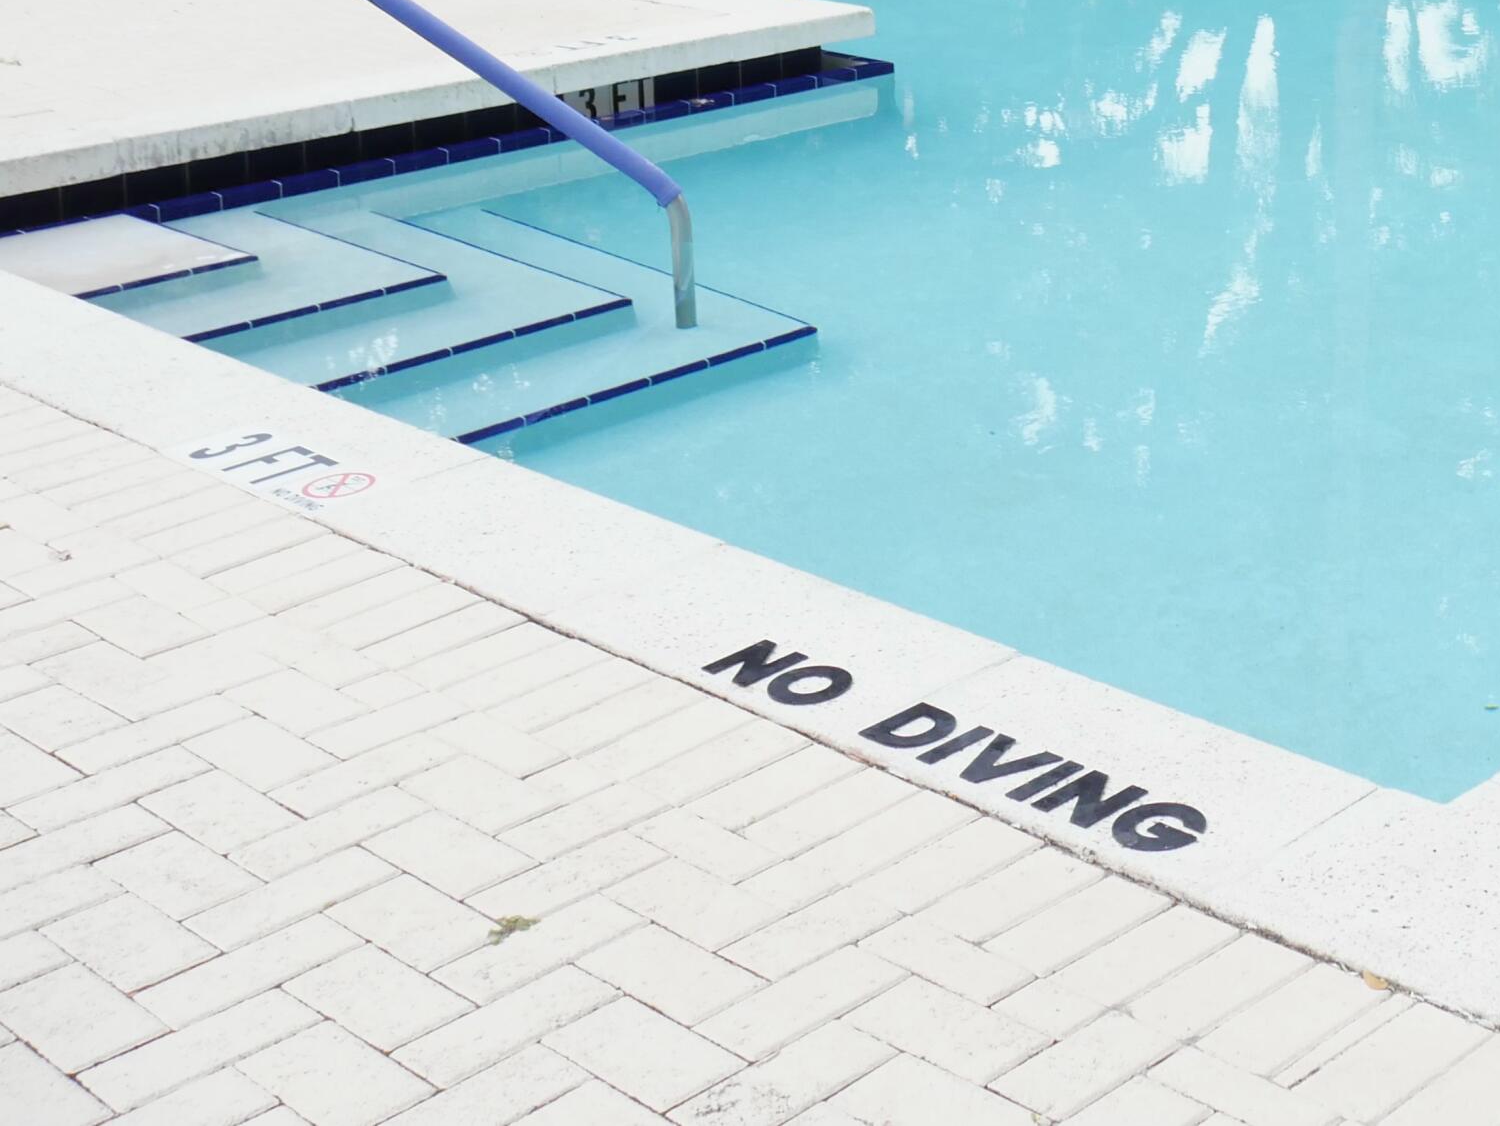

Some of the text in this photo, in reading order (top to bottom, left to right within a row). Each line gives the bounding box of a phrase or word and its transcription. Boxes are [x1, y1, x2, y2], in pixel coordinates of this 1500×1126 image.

[578, 77, 652, 120] 3 FT
[189, 433, 339, 484] 3 FT
[701, 639, 1207, 852] NO DIVING
